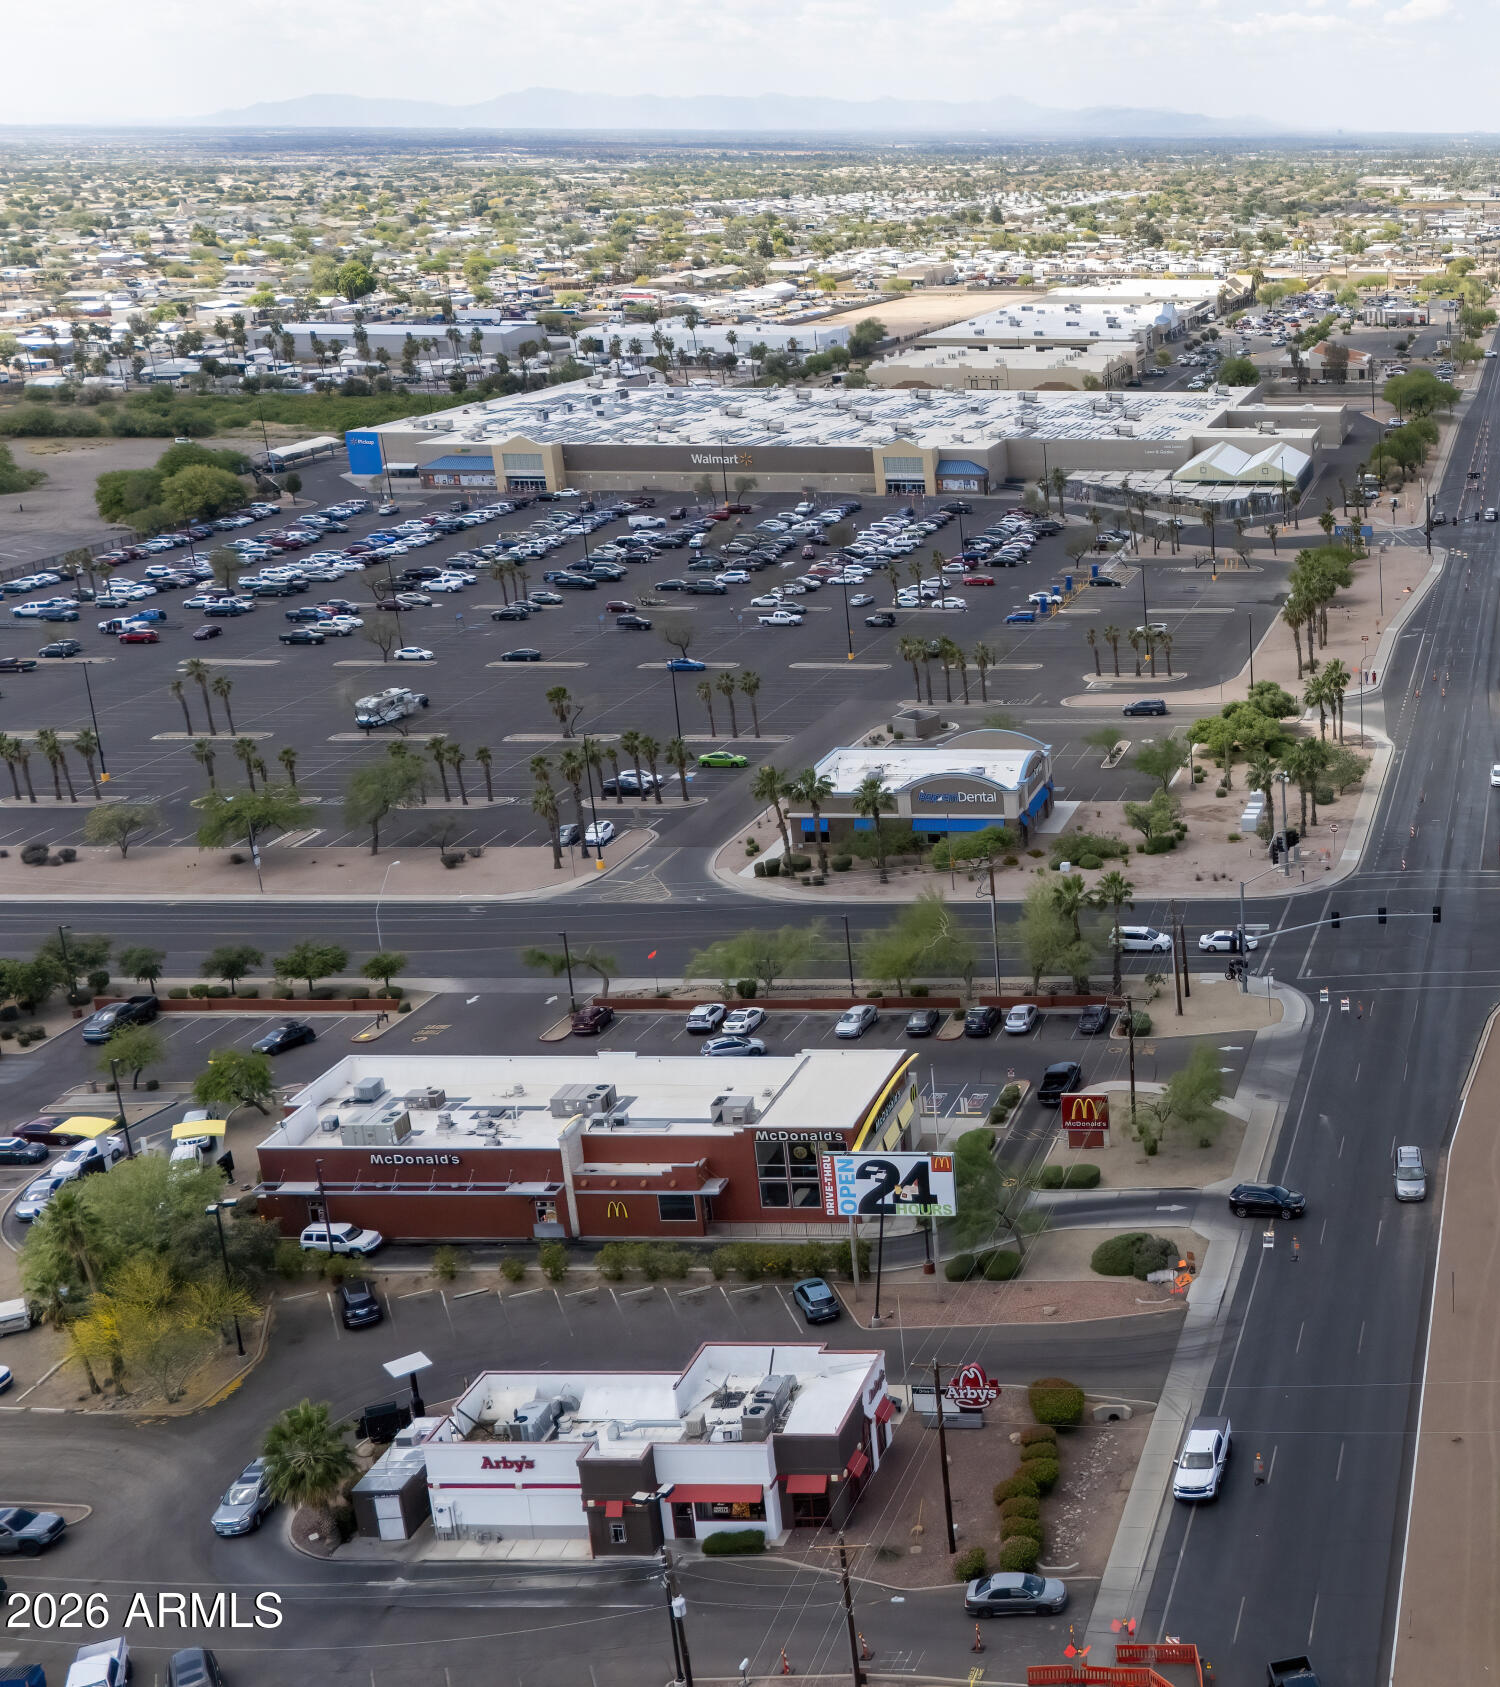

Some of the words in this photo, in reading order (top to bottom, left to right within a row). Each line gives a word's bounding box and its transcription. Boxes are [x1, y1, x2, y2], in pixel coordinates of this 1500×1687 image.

[691, 453, 739, 464] Walmart
[958, 791, 997, 803] Dental
[755, 1130, 843, 1141] McDonald's
[370, 1154, 460, 1165] McDonald's
[822, 1155, 836, 1216] DRIVE-THRU
[837, 1158, 858, 1215] OPEN
[855, 1159, 939, 1215] 24
[896, 1204, 953, 1215] HOURS
[945, 1386, 997, 1403] Arby's
[480, 1455, 536, 1473] Arby's
